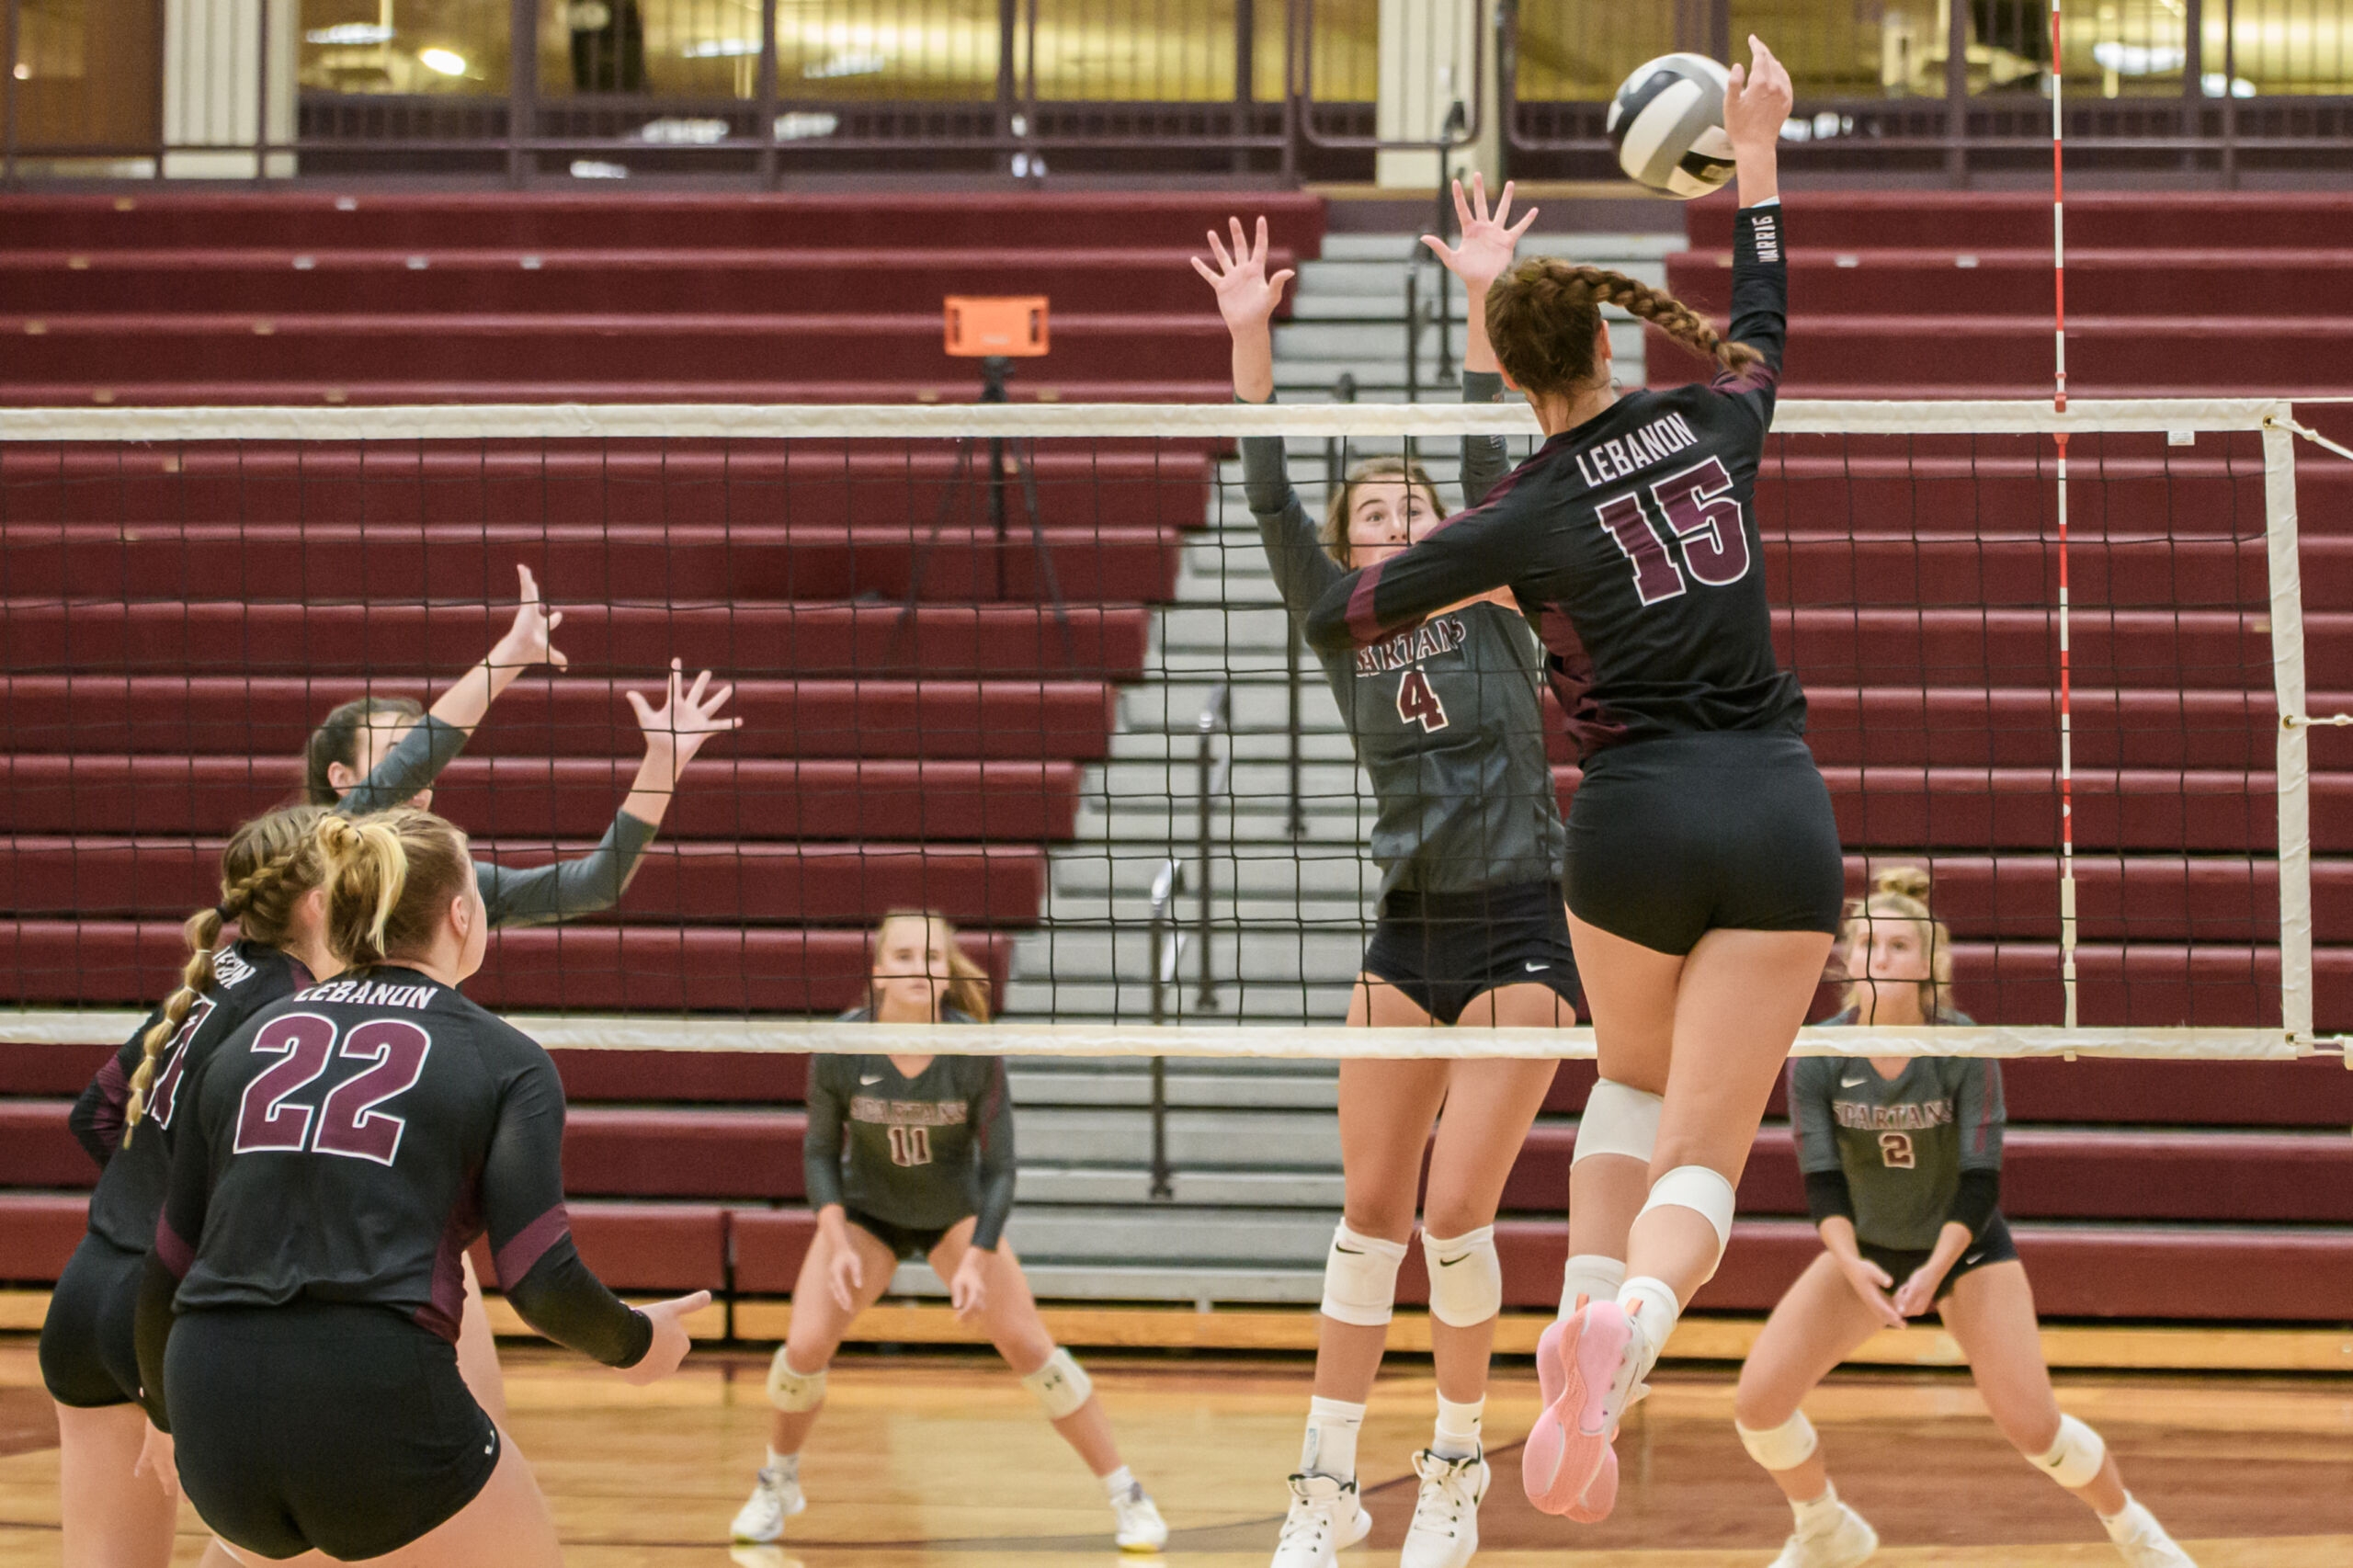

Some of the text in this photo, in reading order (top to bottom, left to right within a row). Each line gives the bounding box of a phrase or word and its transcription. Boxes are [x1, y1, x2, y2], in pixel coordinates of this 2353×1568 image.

[1575, 412, 1699, 488] LEBANON
[1595, 455, 1750, 607] 15
[1396, 665, 1449, 733] 4
[294, 980, 438, 1010] LEBANON
[233, 1012, 431, 1167] 22
[887, 1125, 933, 1167] 11
[1878, 1131, 1915, 1169] 2
